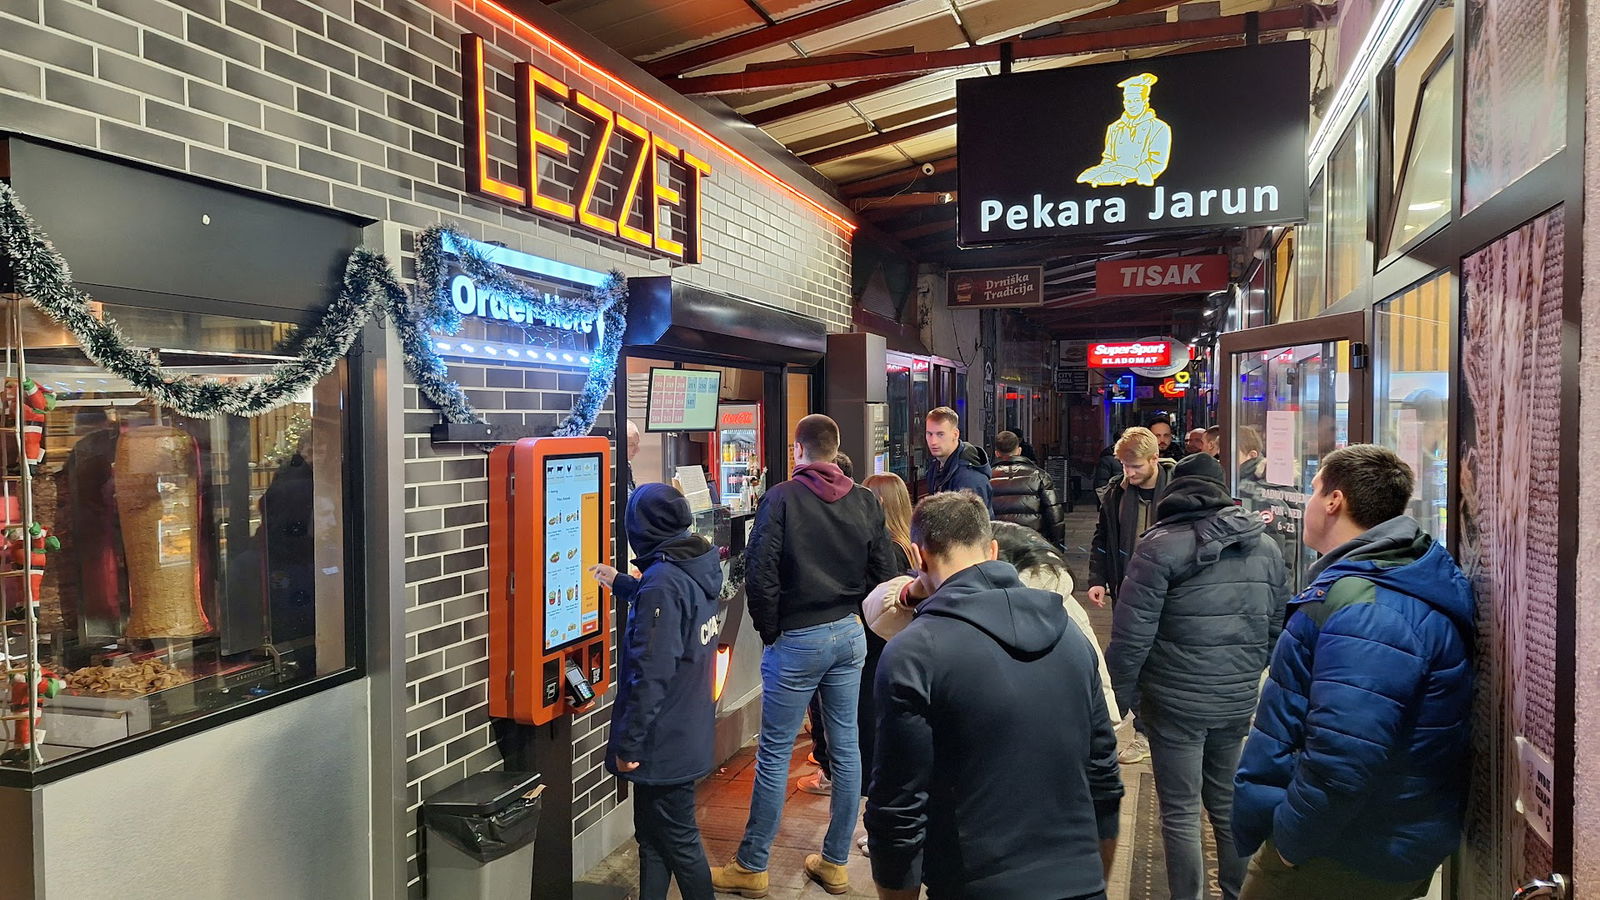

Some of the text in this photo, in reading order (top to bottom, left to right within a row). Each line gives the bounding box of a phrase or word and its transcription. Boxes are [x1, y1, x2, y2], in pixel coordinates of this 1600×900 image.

[462, 34, 712, 264] LEZZET
[980, 185, 1279, 233] Pekara Jarun
[985, 273, 1029, 291] Drniška
[1120, 263, 1205, 288] TISAK
[984, 283, 1035, 301] Tradicija
[1094, 343, 1166, 356] SuperSport
[1101, 356, 1158, 364] KLADOMAT
